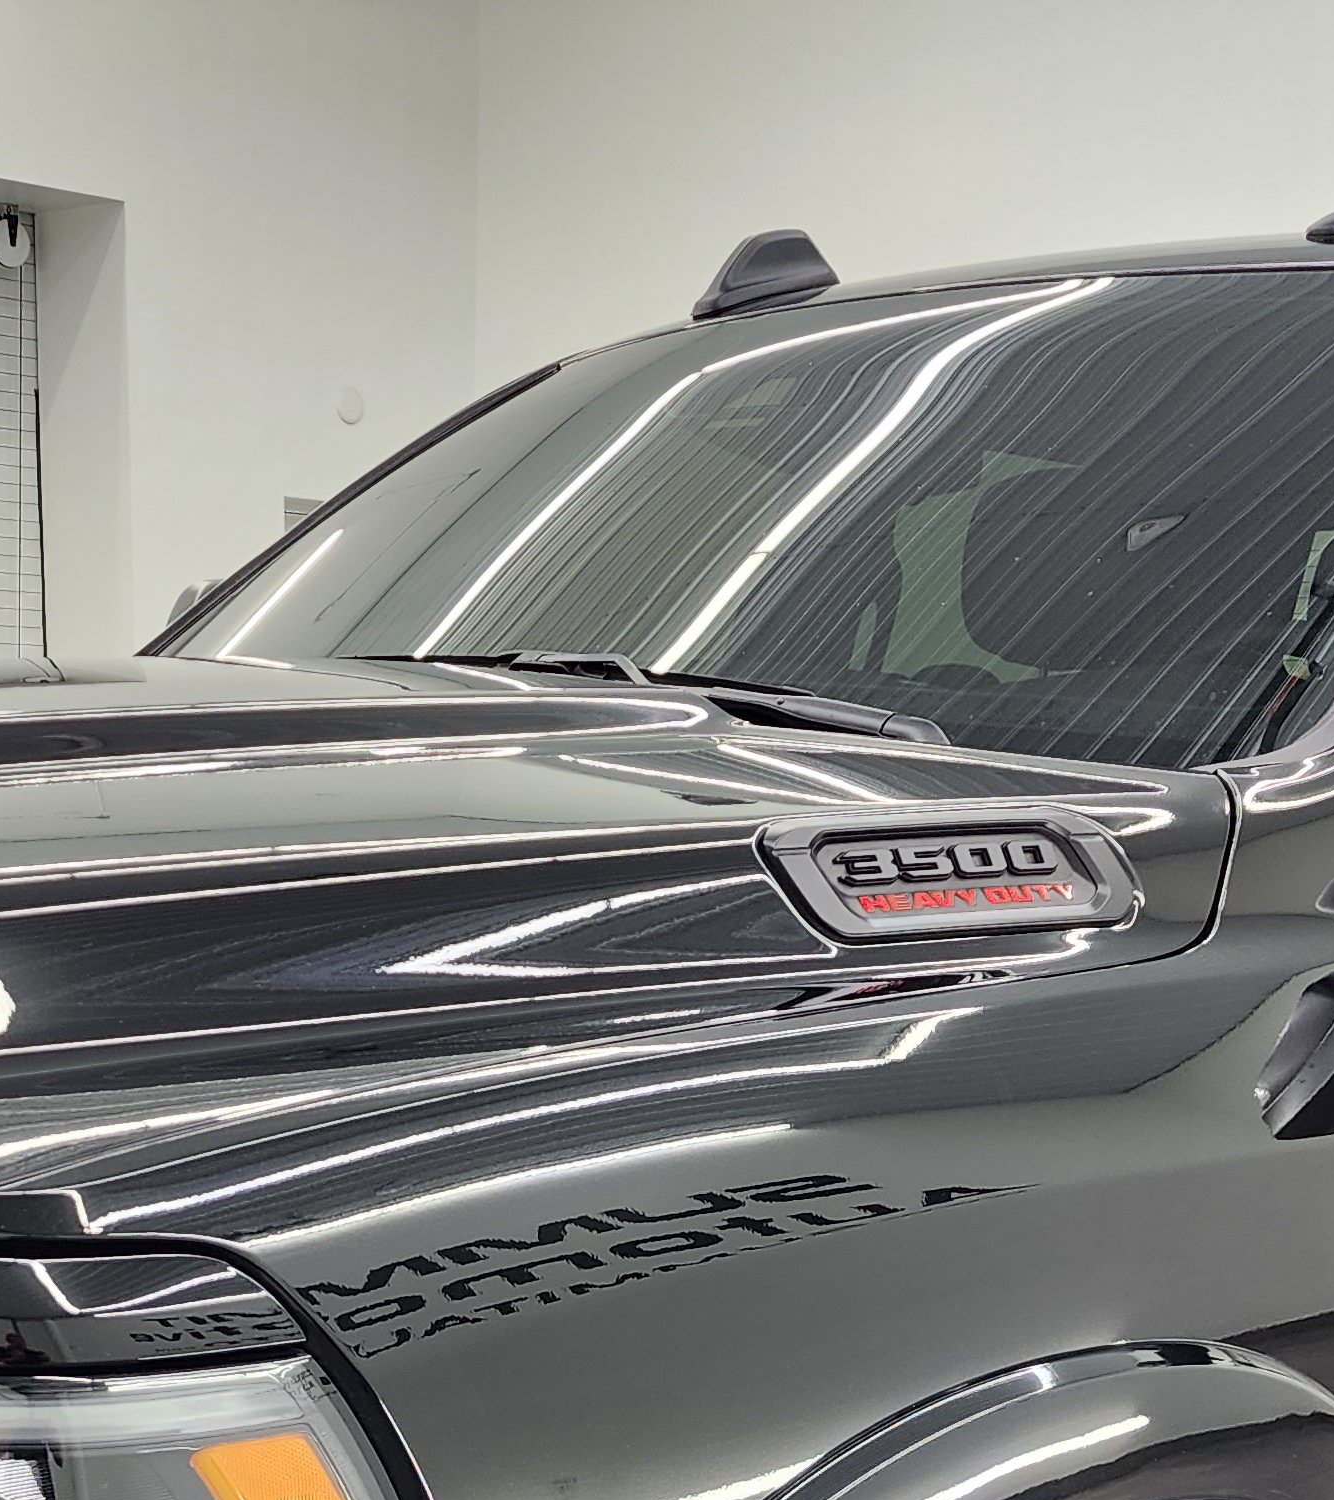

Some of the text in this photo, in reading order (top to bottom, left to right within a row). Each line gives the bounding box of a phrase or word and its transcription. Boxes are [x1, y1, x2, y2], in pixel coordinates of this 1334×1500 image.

[833, 839, 1060, 888] 3500
[859, 883, 1074, 914] HEAVY DUTY
